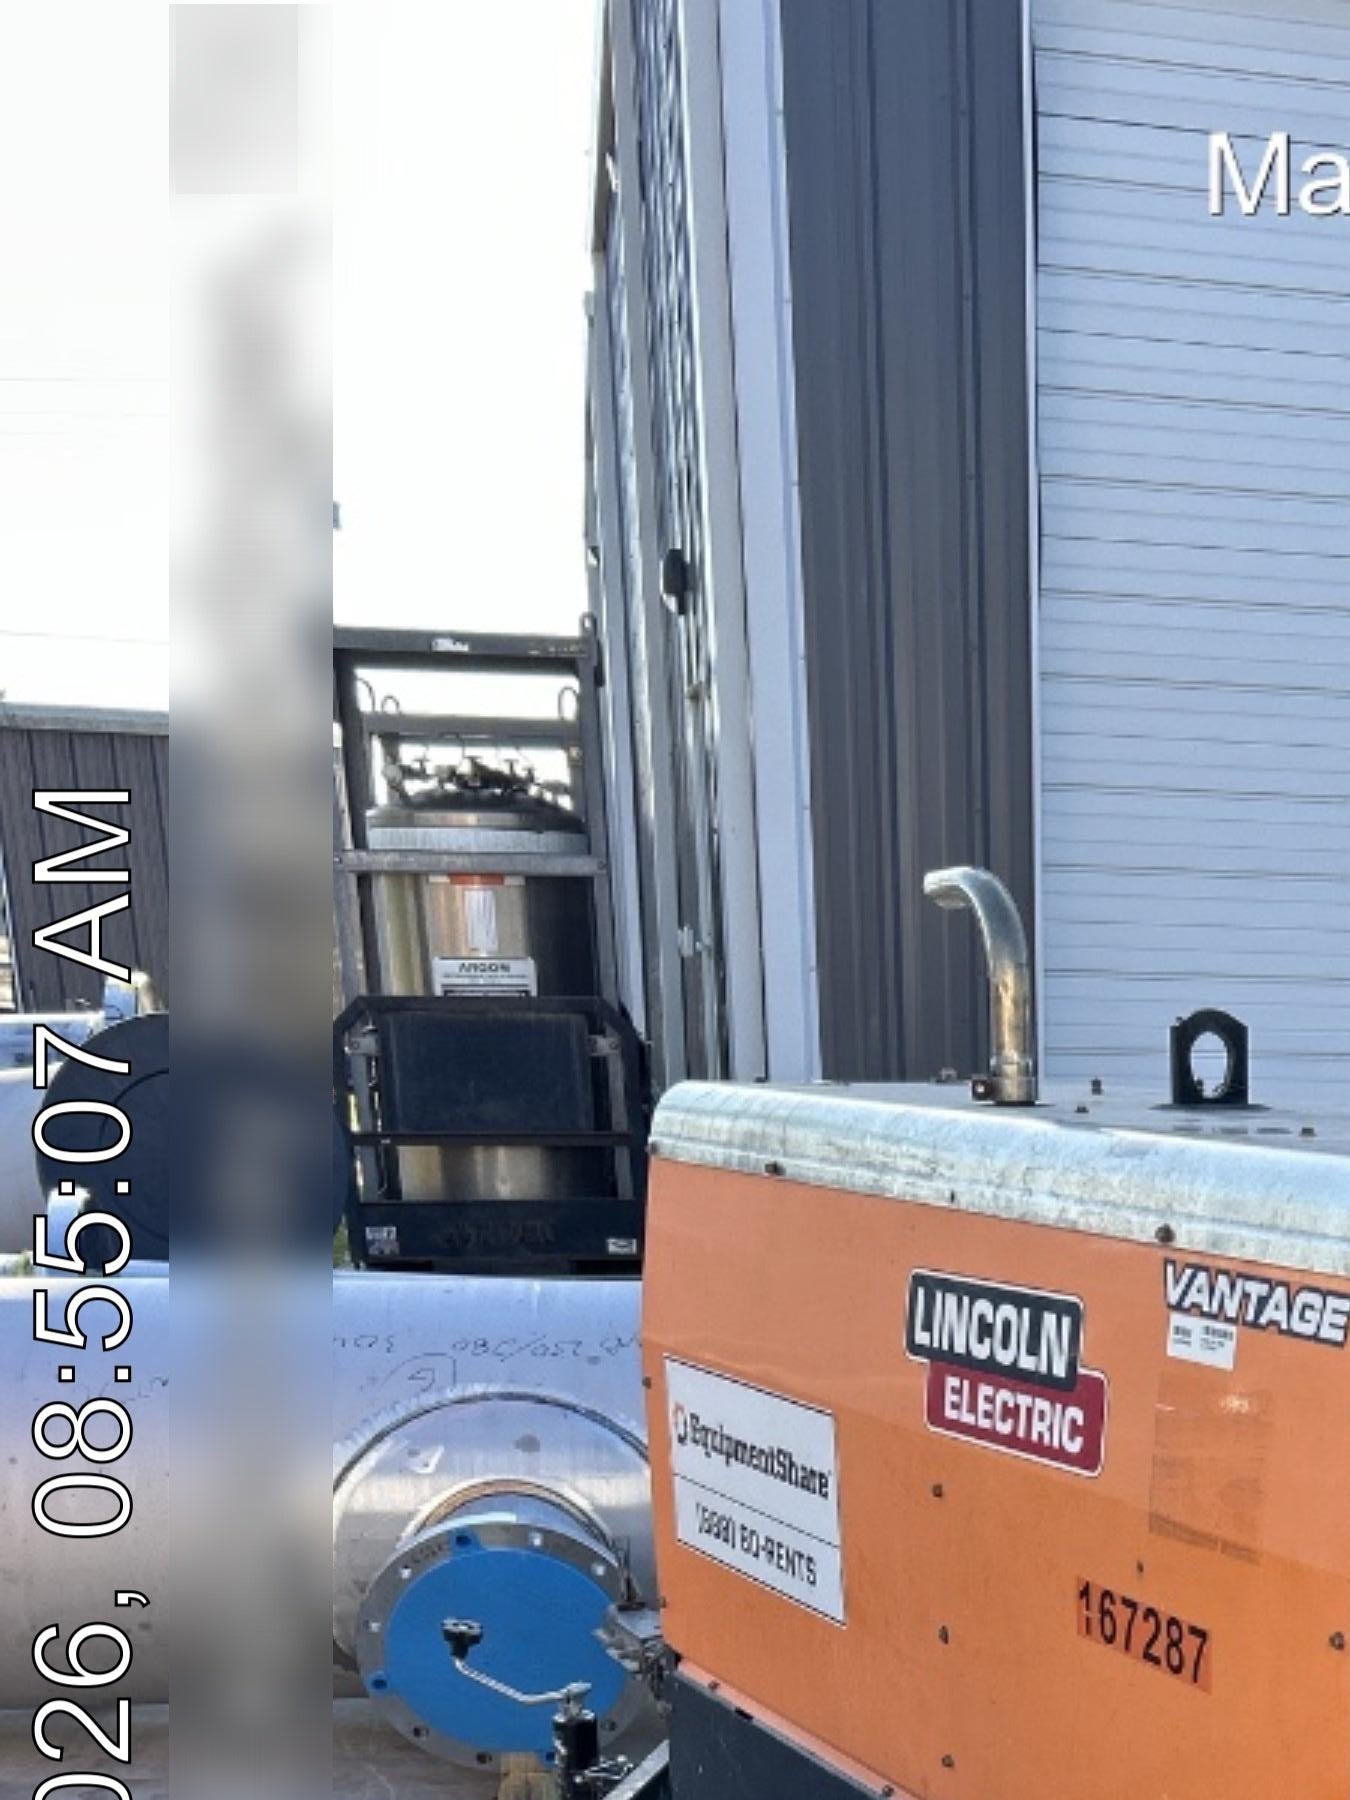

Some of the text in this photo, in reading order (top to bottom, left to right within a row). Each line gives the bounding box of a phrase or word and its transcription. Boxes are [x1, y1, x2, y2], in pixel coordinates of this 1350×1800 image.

[914, 1286, 1072, 1379] LINCOLN
[689, 1412, 830, 1500] EquipmentShare
[943, 1375, 1085, 1454] ELECTRIC
[1079, 1580, 1208, 1684] 167287
